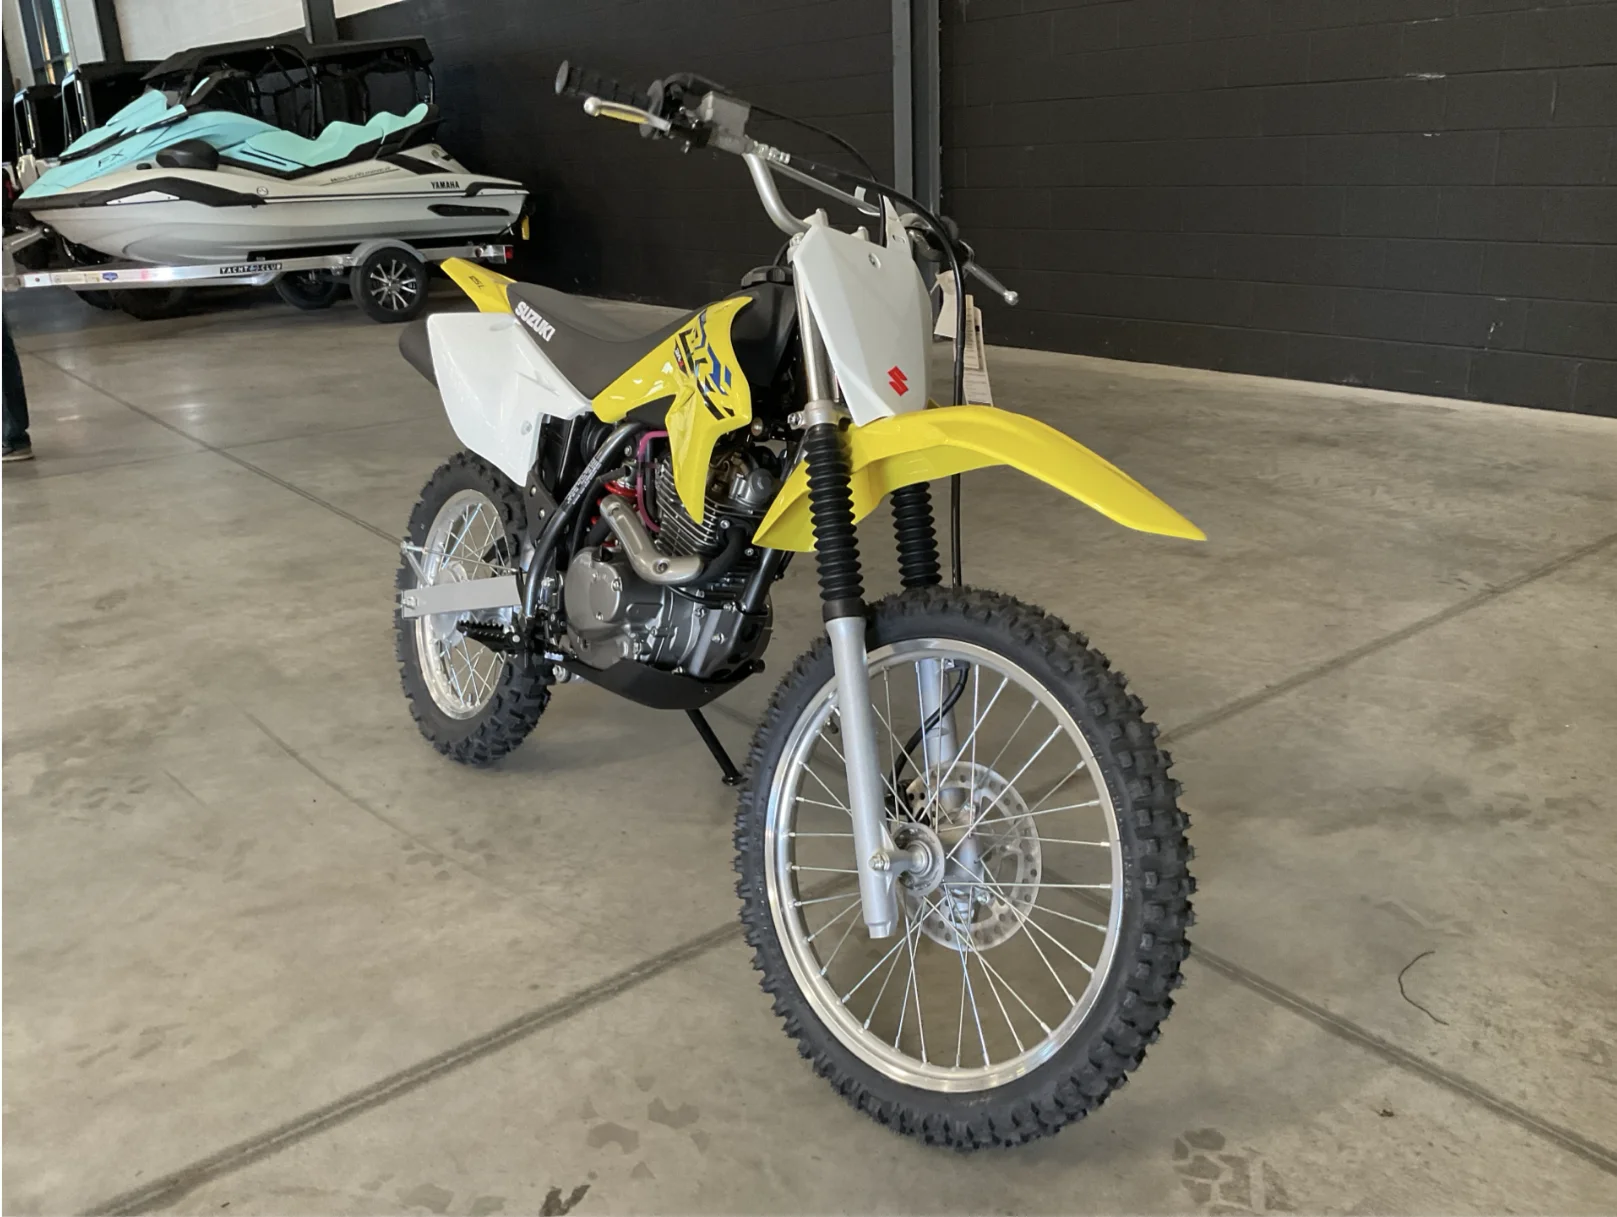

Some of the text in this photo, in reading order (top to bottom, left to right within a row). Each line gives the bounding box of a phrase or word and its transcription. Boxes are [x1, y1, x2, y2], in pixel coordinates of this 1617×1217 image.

[430, 180, 460, 189] YAMAHA
[221, 264, 248, 273] YACHT
[514, 301, 556, 342] SUZUKI
